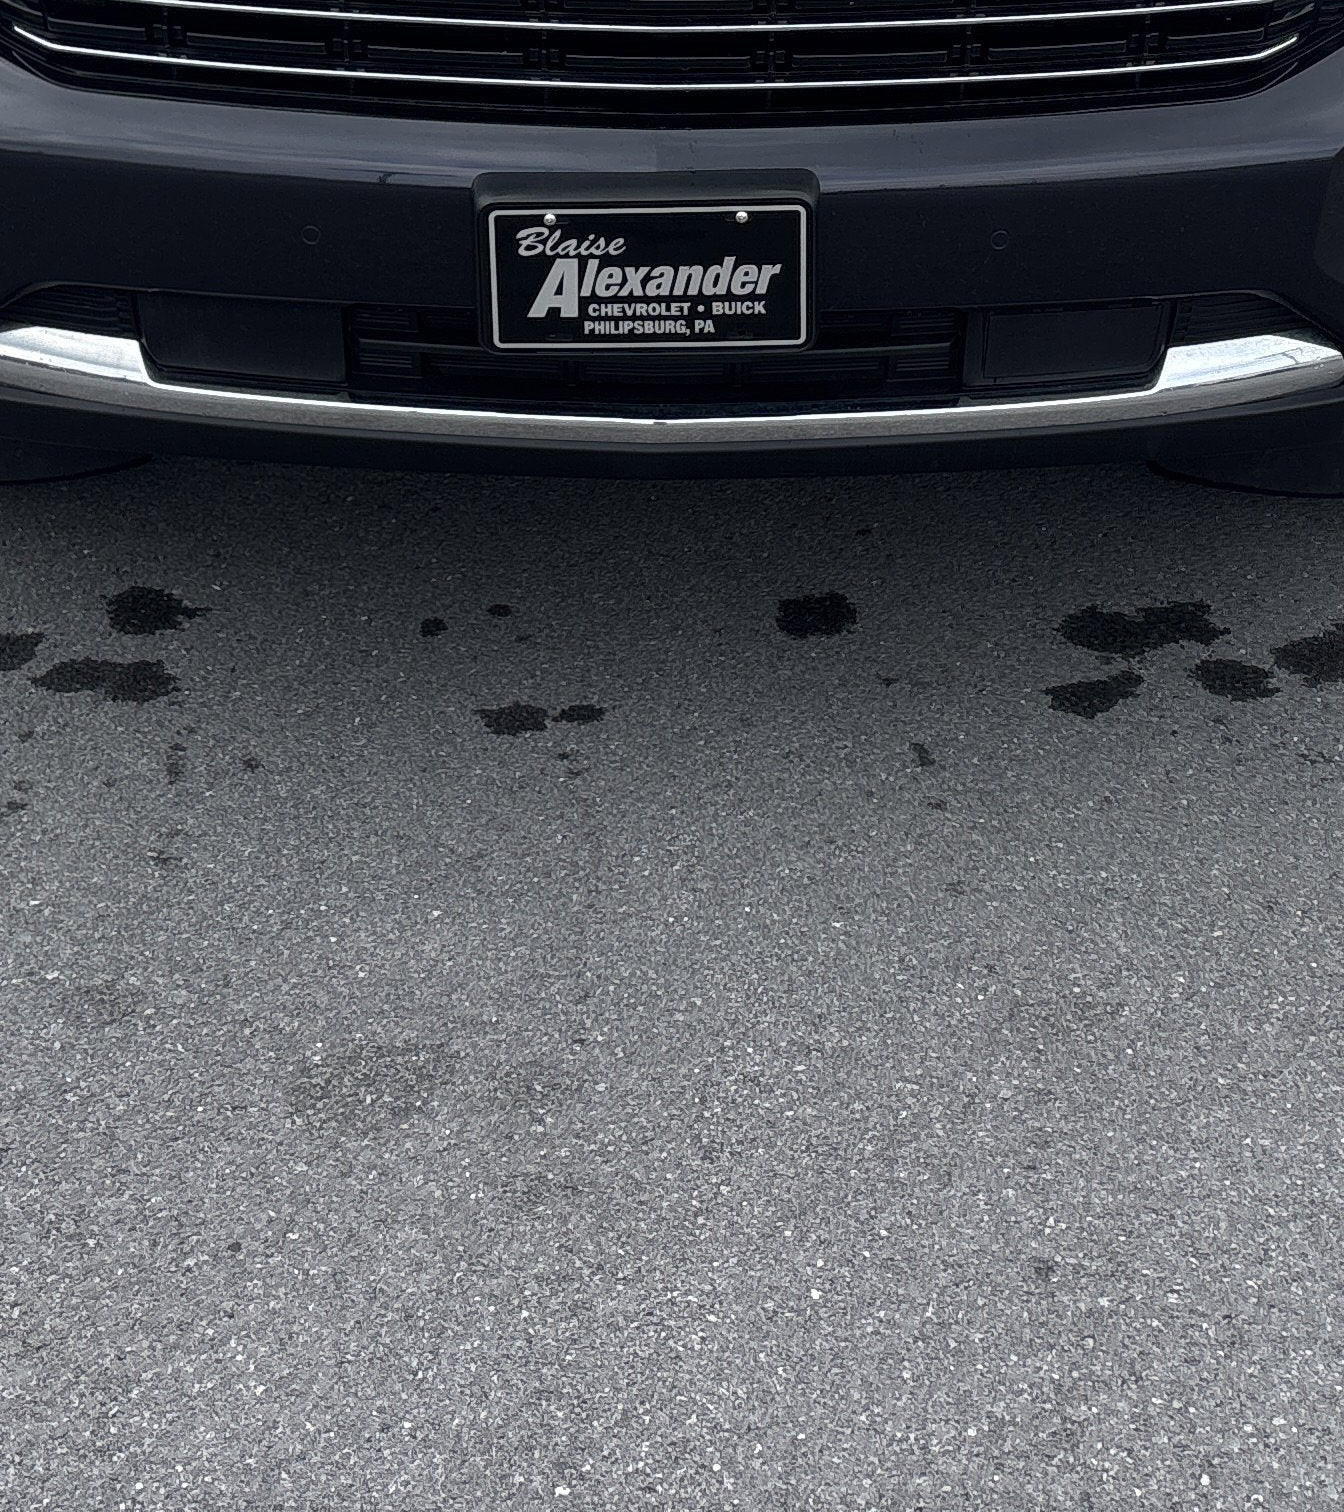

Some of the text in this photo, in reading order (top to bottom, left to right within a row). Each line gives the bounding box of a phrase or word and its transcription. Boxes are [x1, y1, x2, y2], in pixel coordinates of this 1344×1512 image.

[516, 227, 626, 257] Blaise
[527, 256, 782, 318] Alexander
[588, 300, 767, 317] CHEVROLET BUICK
[584, 319, 716, 336] PHILIPSBURG, PA
